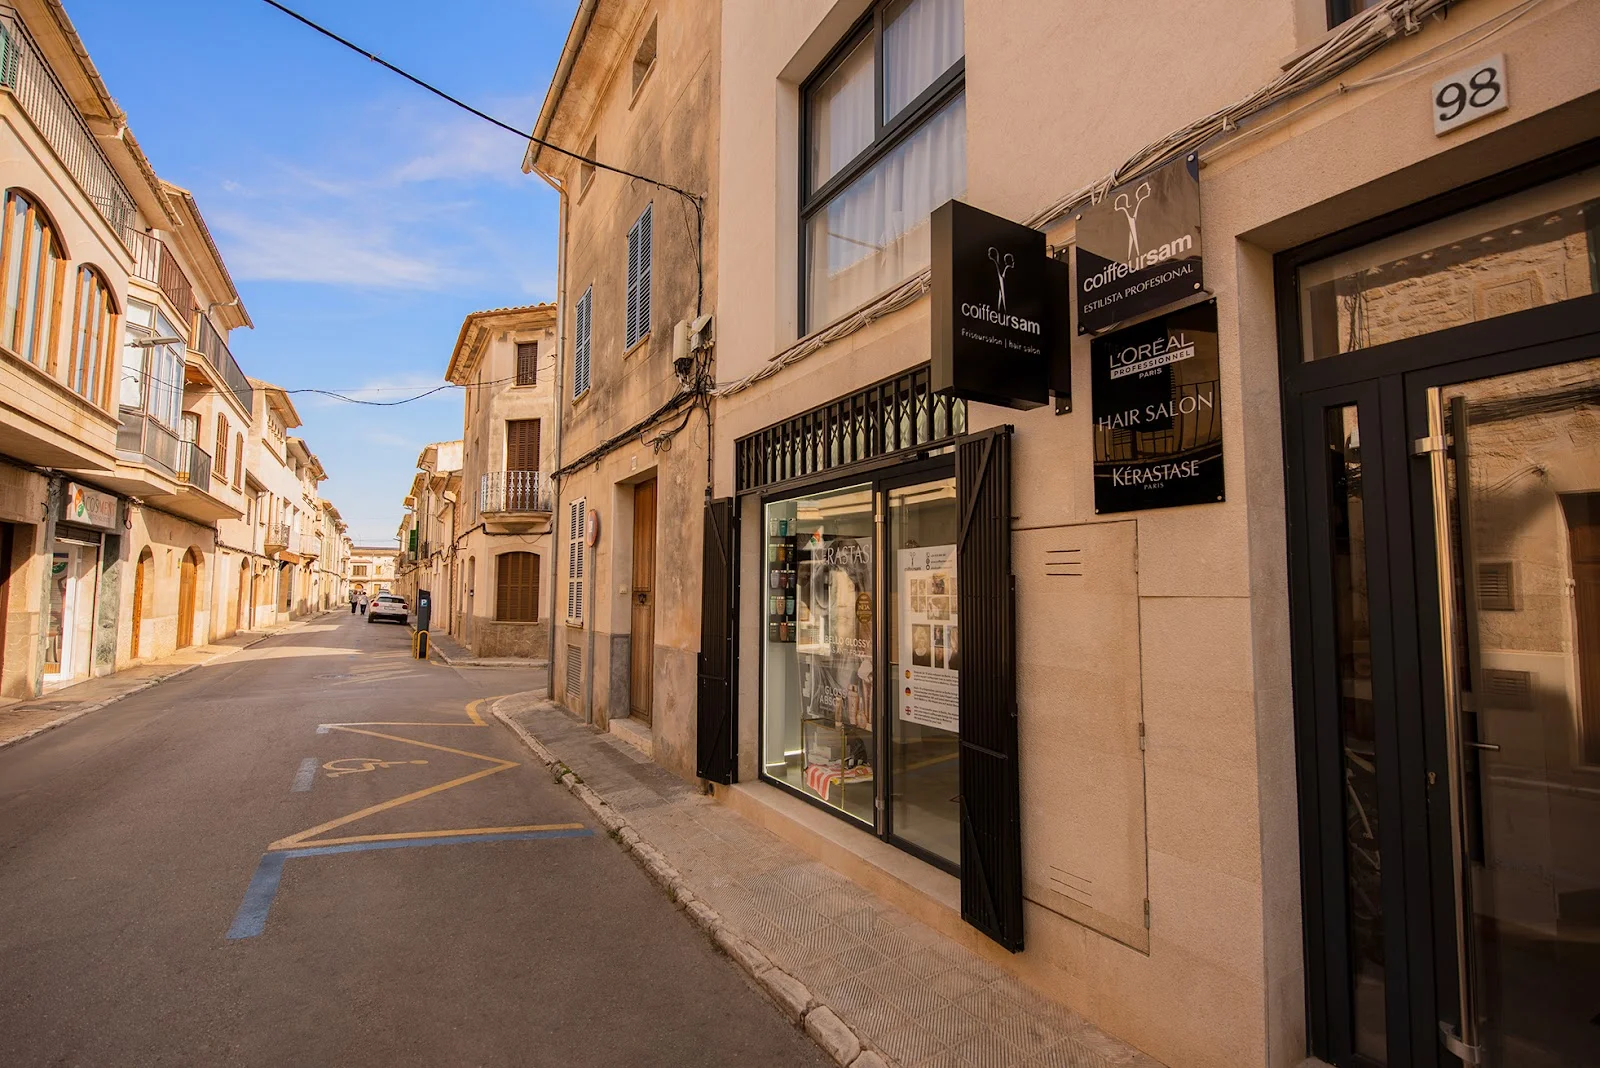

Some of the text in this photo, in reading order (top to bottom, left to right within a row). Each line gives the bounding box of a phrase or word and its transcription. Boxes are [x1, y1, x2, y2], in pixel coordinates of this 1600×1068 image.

[1436, 67, 1501, 121] 98
[1083, 233, 1193, 293] coiffeursam
[1083, 263, 1194, 314] ESTILISTA PROFESIONAL
[961, 302, 1041, 336] coiffeursam
[1008, 340, 1022, 351] hair
[1023, 345, 1041, 355] salon
[1113, 350, 1191, 377] PROFESSIONNEL
[1139, 367, 1163, 379] PARIS
[1098, 391, 1213, 432] HAIR SALON
[1112, 459, 1200, 487] KÉRASTASE
[1143, 482, 1165, 490] PARIS
[844, 637, 871, 648] GLOSSY
